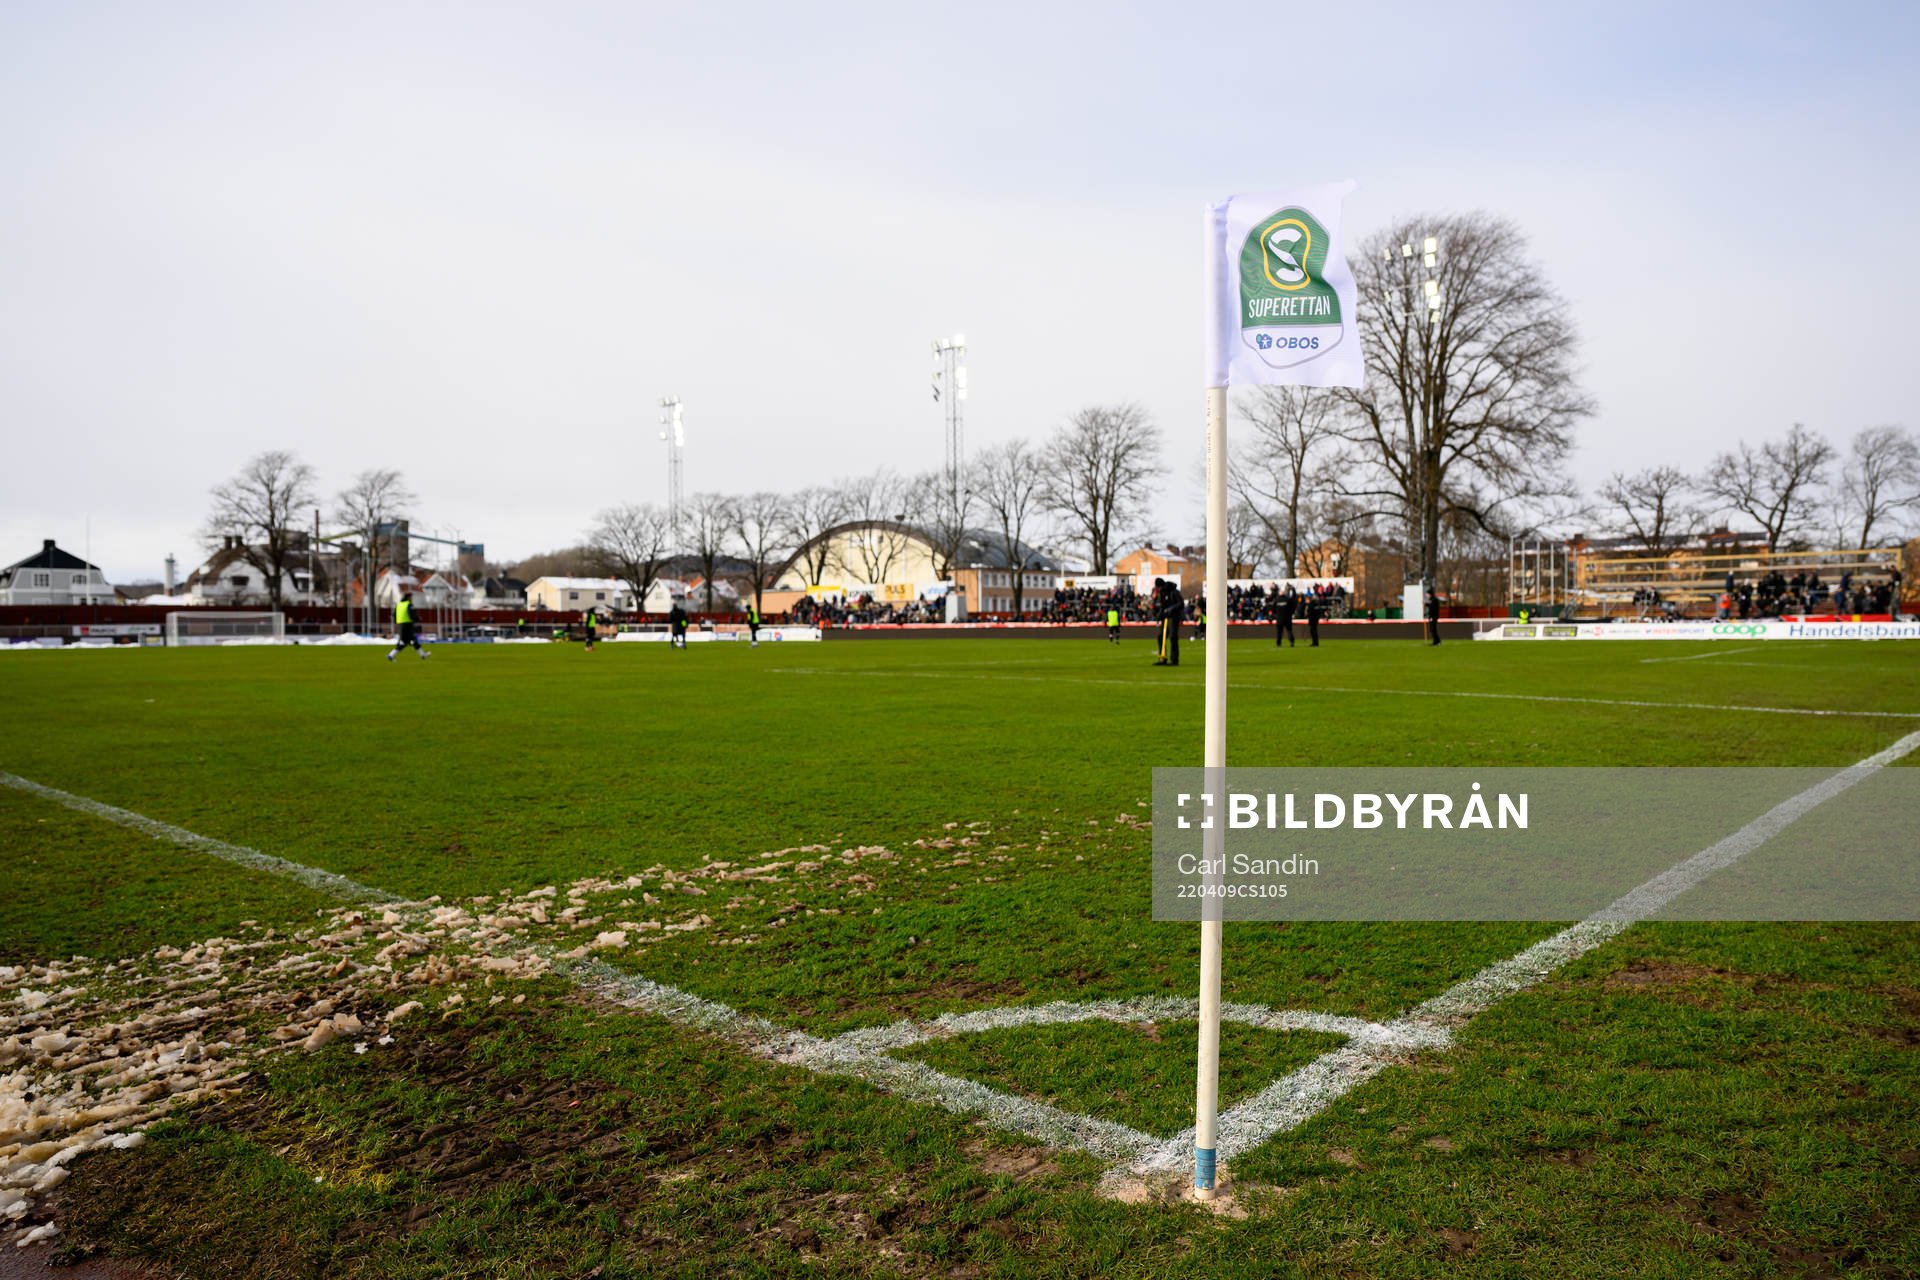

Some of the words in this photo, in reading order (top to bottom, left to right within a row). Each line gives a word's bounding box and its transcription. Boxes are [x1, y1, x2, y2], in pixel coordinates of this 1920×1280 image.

[1248, 295, 1331, 318] SUPERETTAN
[1276, 336, 1319, 349] OBOS
[1712, 624, 1767, 637] coop
